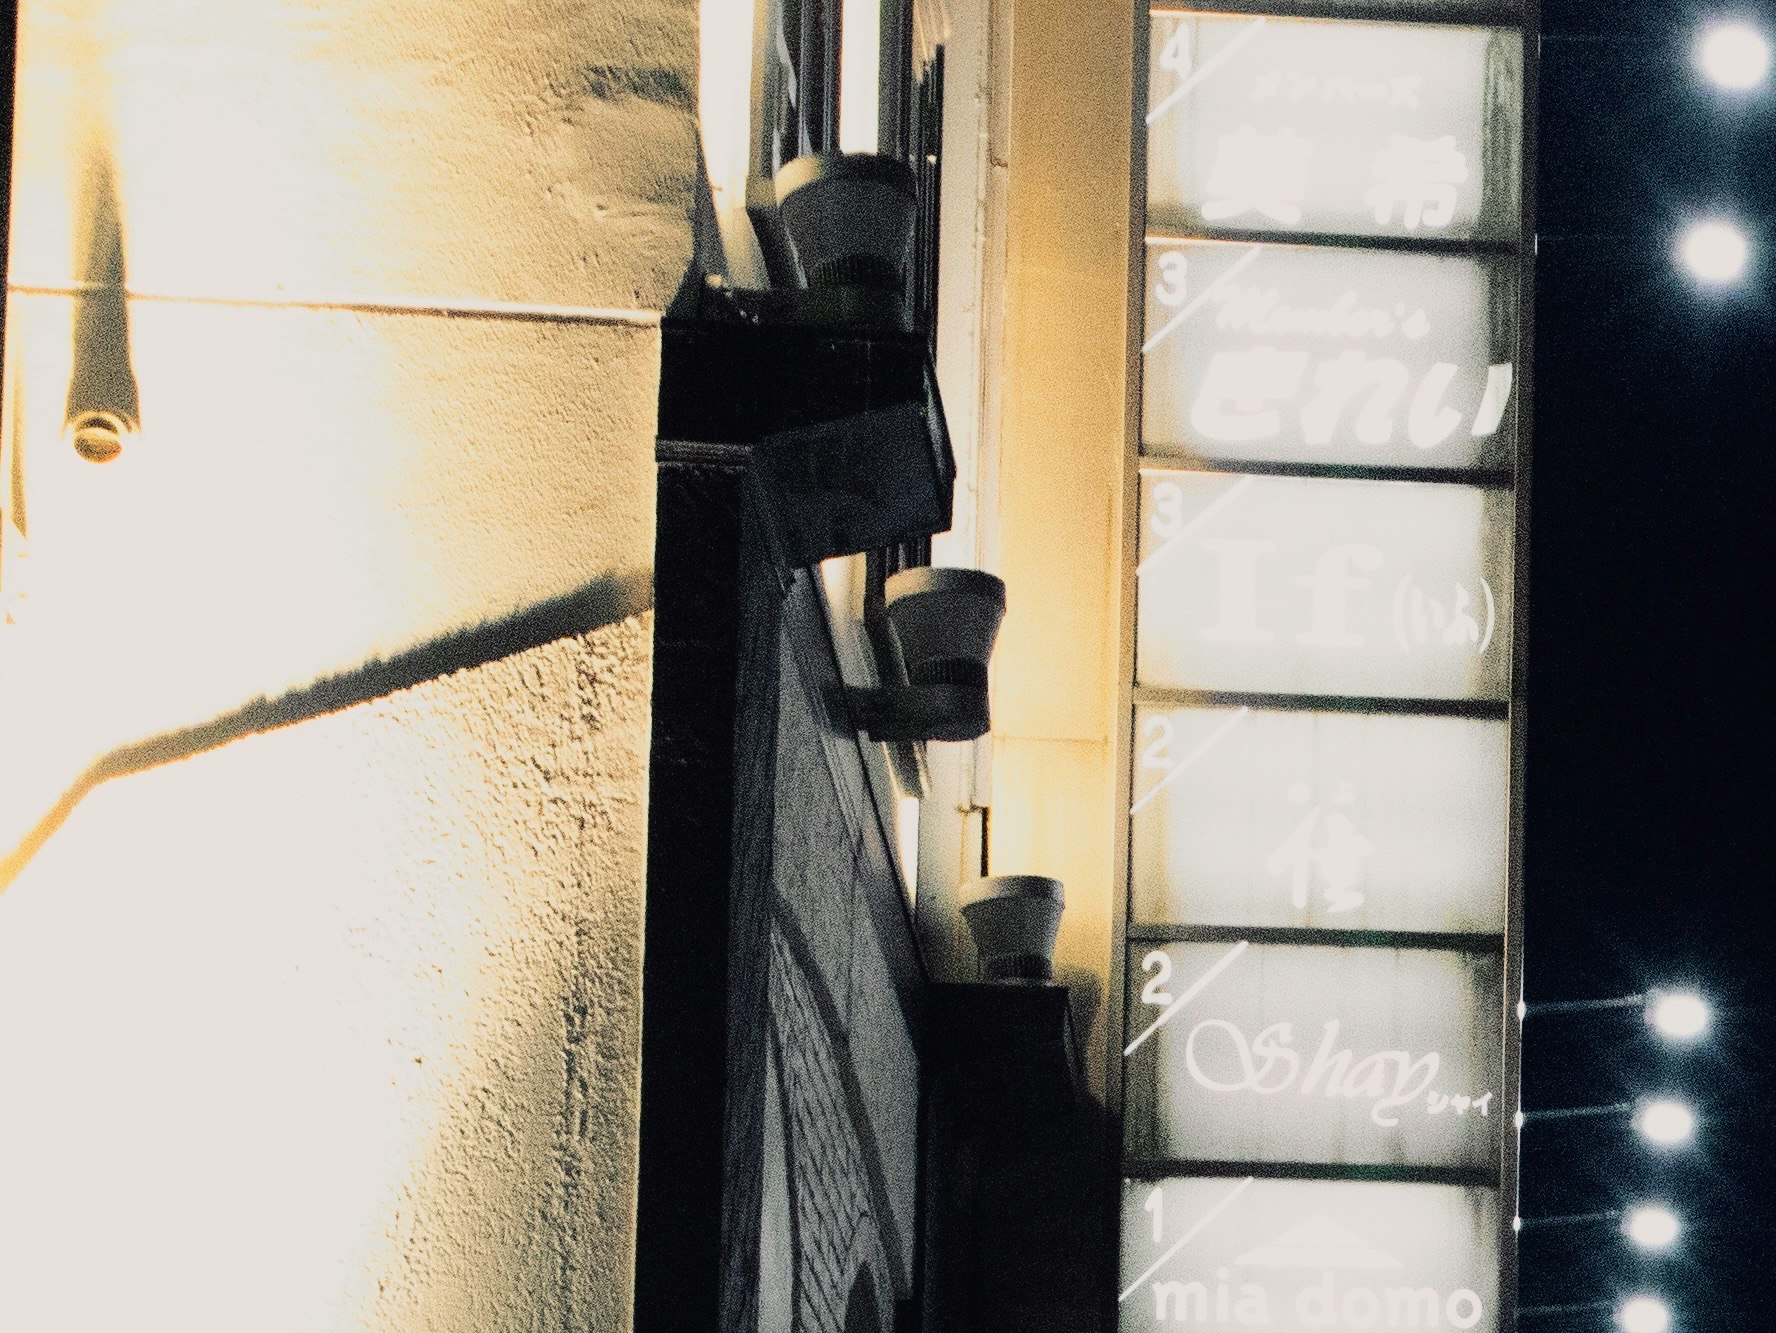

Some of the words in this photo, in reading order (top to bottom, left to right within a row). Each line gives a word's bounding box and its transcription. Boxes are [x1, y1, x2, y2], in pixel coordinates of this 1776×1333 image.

[1250, 69, 1422, 109] メンバーズ
[1199, 539, 1384, 646] If
[1141, 951, 1174, 1005] 2
[1426, 1090, 1492, 1116] シャイ
[1144, 1187, 1164, 1243] 1
[1153, 1267, 1271, 1325] mia
[1296, 1268, 1482, 1329] domo
